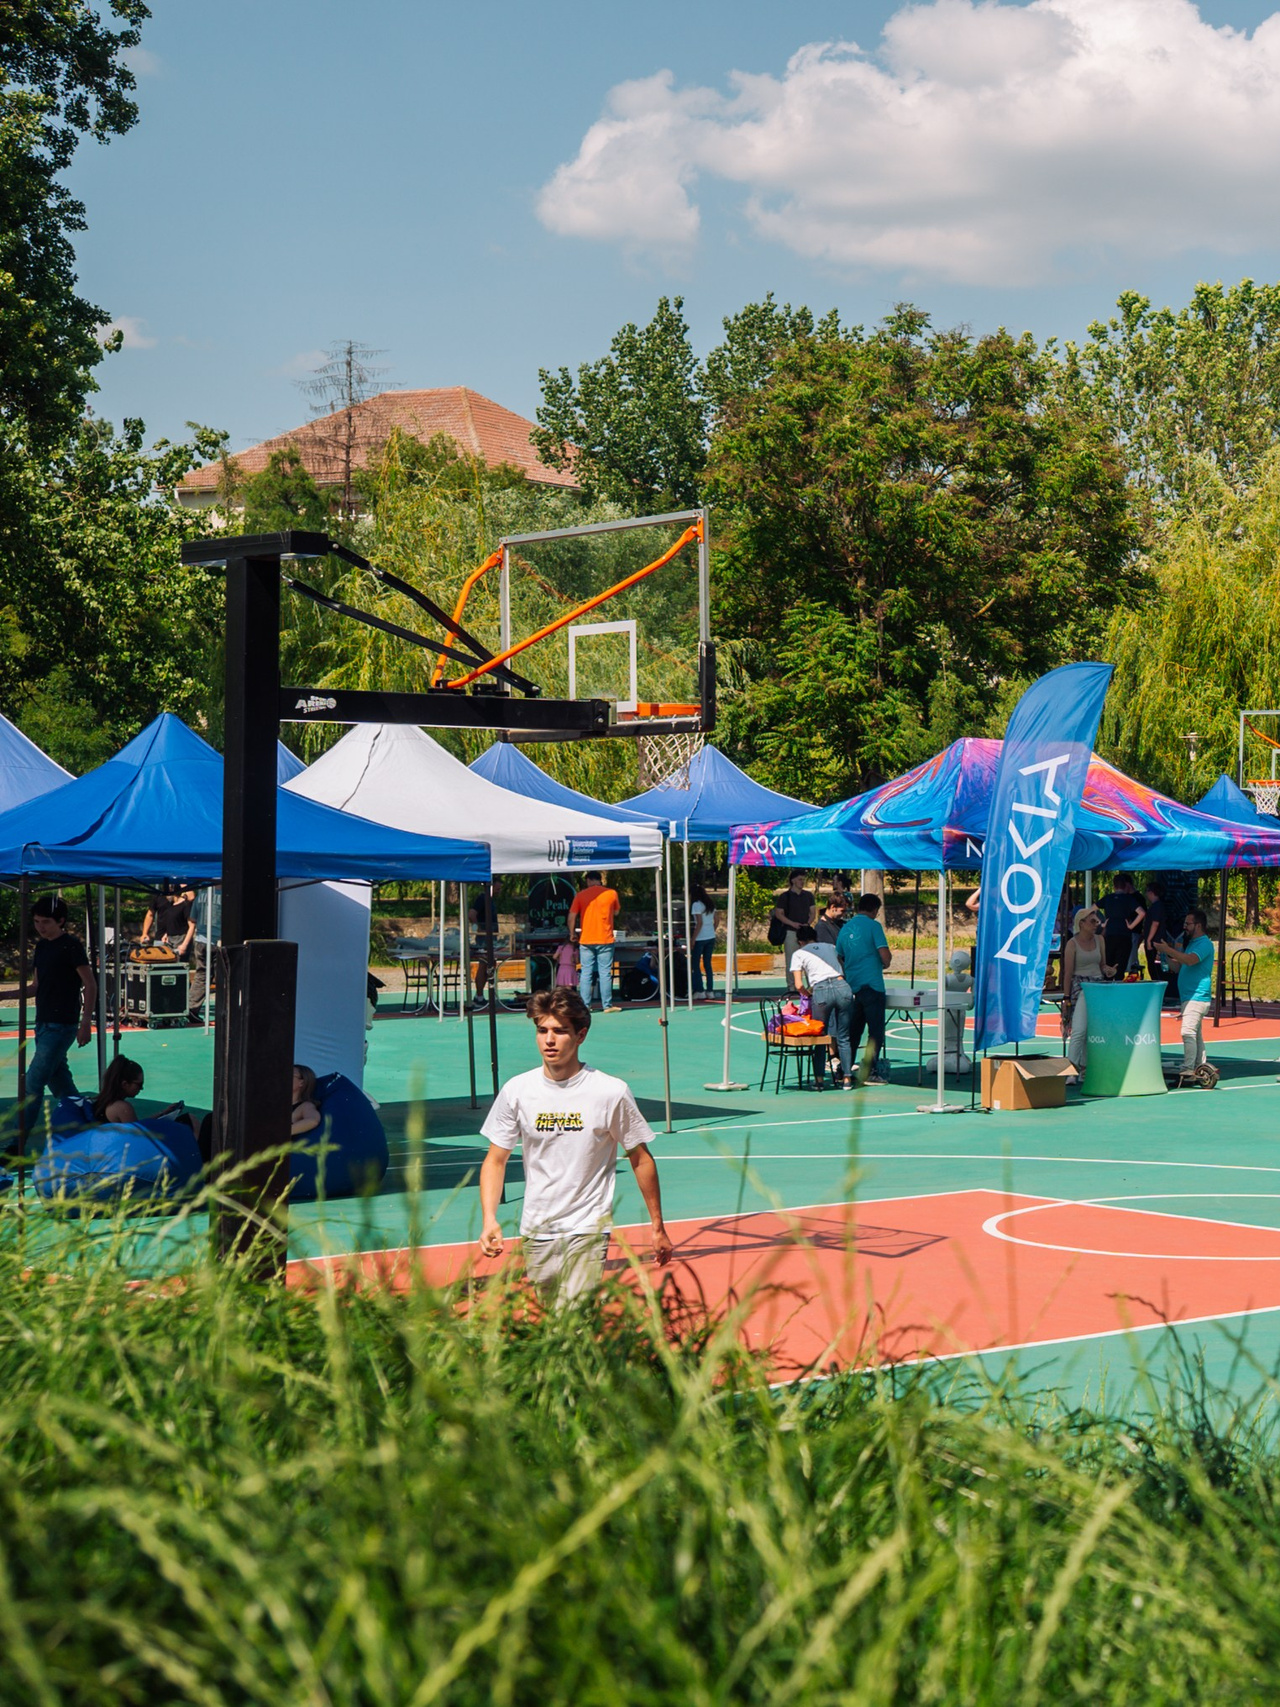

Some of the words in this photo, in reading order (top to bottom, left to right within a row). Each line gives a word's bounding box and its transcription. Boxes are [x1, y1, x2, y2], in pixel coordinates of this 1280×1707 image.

[744, 834, 797, 856] NOKIA
[993, 753, 1070, 965] NOKIA
[546, 898, 570, 910] Peak
[1125, 1033, 1157, 1046] NOKIA
[535, 1119, 555, 1132] THE
[556, 1119, 584, 1132] YEAR
